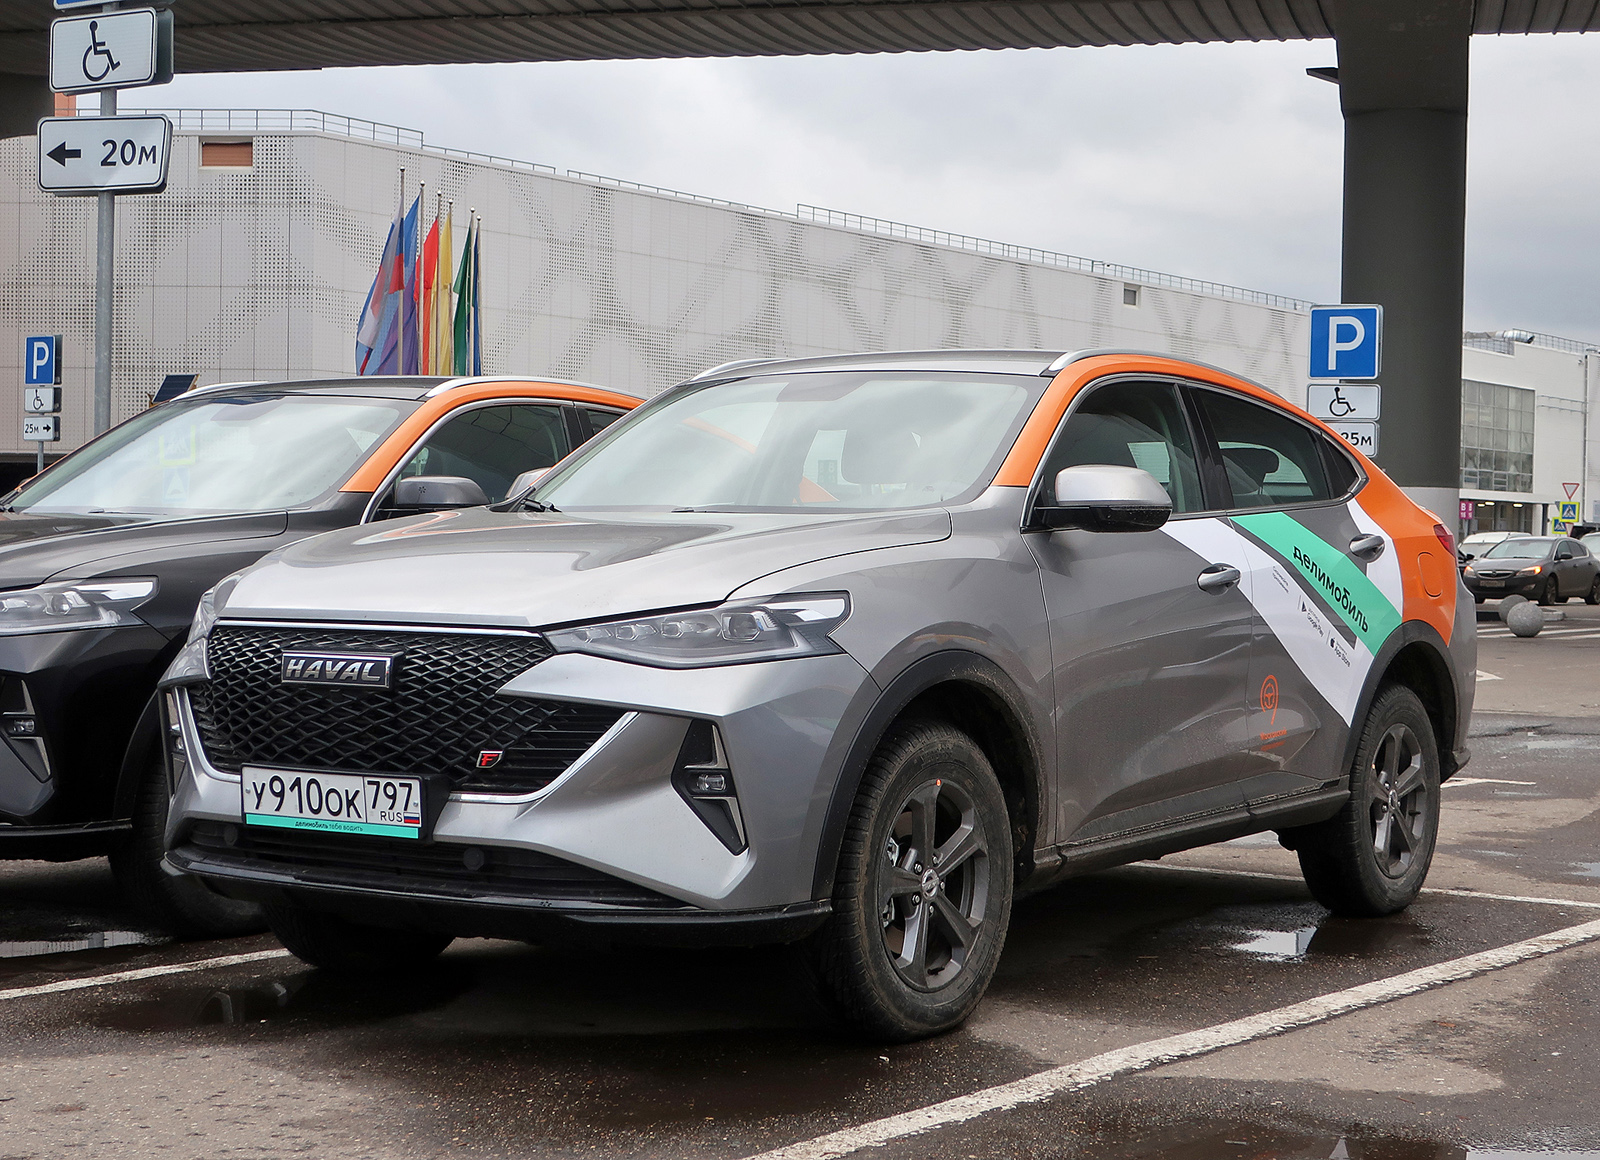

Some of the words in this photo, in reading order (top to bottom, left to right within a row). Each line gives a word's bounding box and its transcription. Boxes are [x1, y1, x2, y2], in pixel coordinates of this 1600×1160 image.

[1328, 316, 1365, 370] P
[32, 342, 50, 380] P
[1292, 546, 1370, 634] делимобиль
[286, 658, 381, 682] HAVAL
[367, 780, 413, 811] 797
[295, 820, 329, 830] делимобиль
[343, 824, 364, 832] водить
[380, 810, 403, 823] RUS
